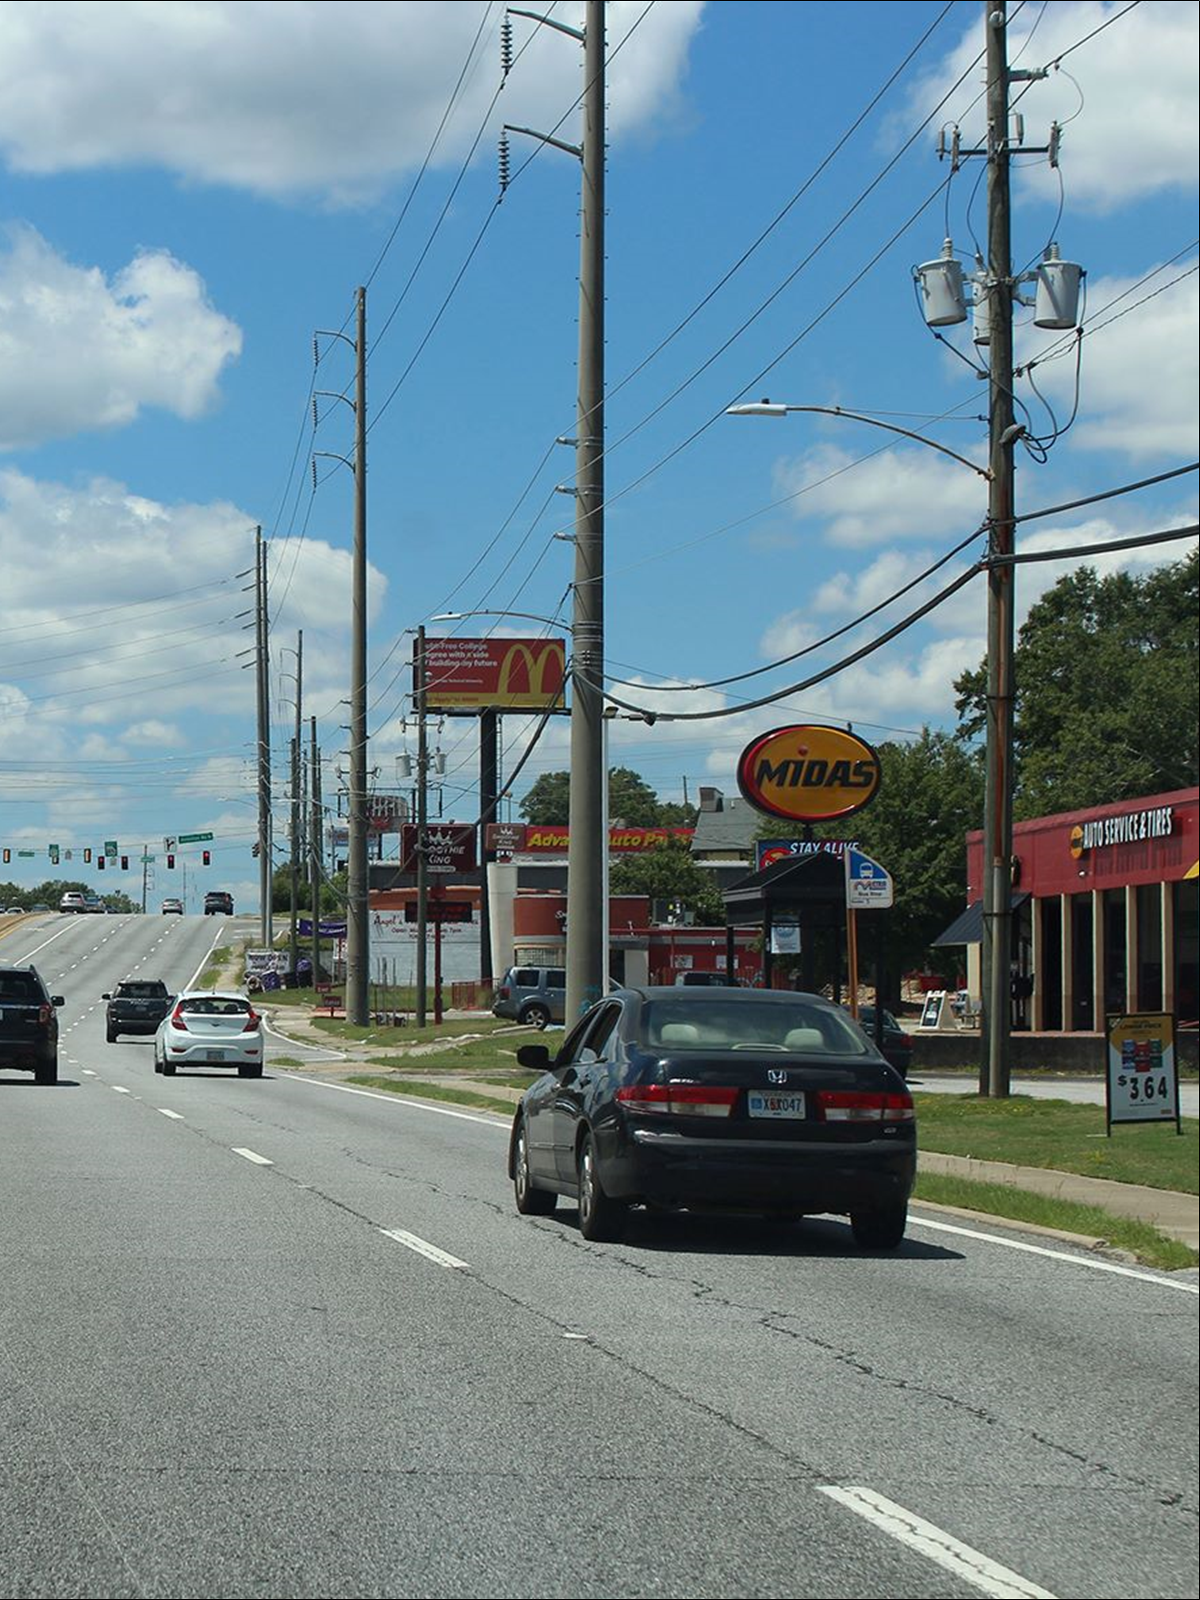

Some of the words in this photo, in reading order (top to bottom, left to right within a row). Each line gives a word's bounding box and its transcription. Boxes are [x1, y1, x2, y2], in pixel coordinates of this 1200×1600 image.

[459, 642, 488, 652] College
[425, 652, 448, 660] egree
[449, 650, 466, 658] with
[473, 650, 489, 658] side
[474, 658, 498, 667] future
[757, 758, 876, 788] MIDAS
[1083, 820, 1104, 849] AUTO
[1104, 813, 1138, 846] SERVICE
[1147, 807, 1172, 838] TIRES
[526, 832, 570, 847] Adva
[608, 835, 640, 847] uto
[790, 842, 820, 854] STAY
